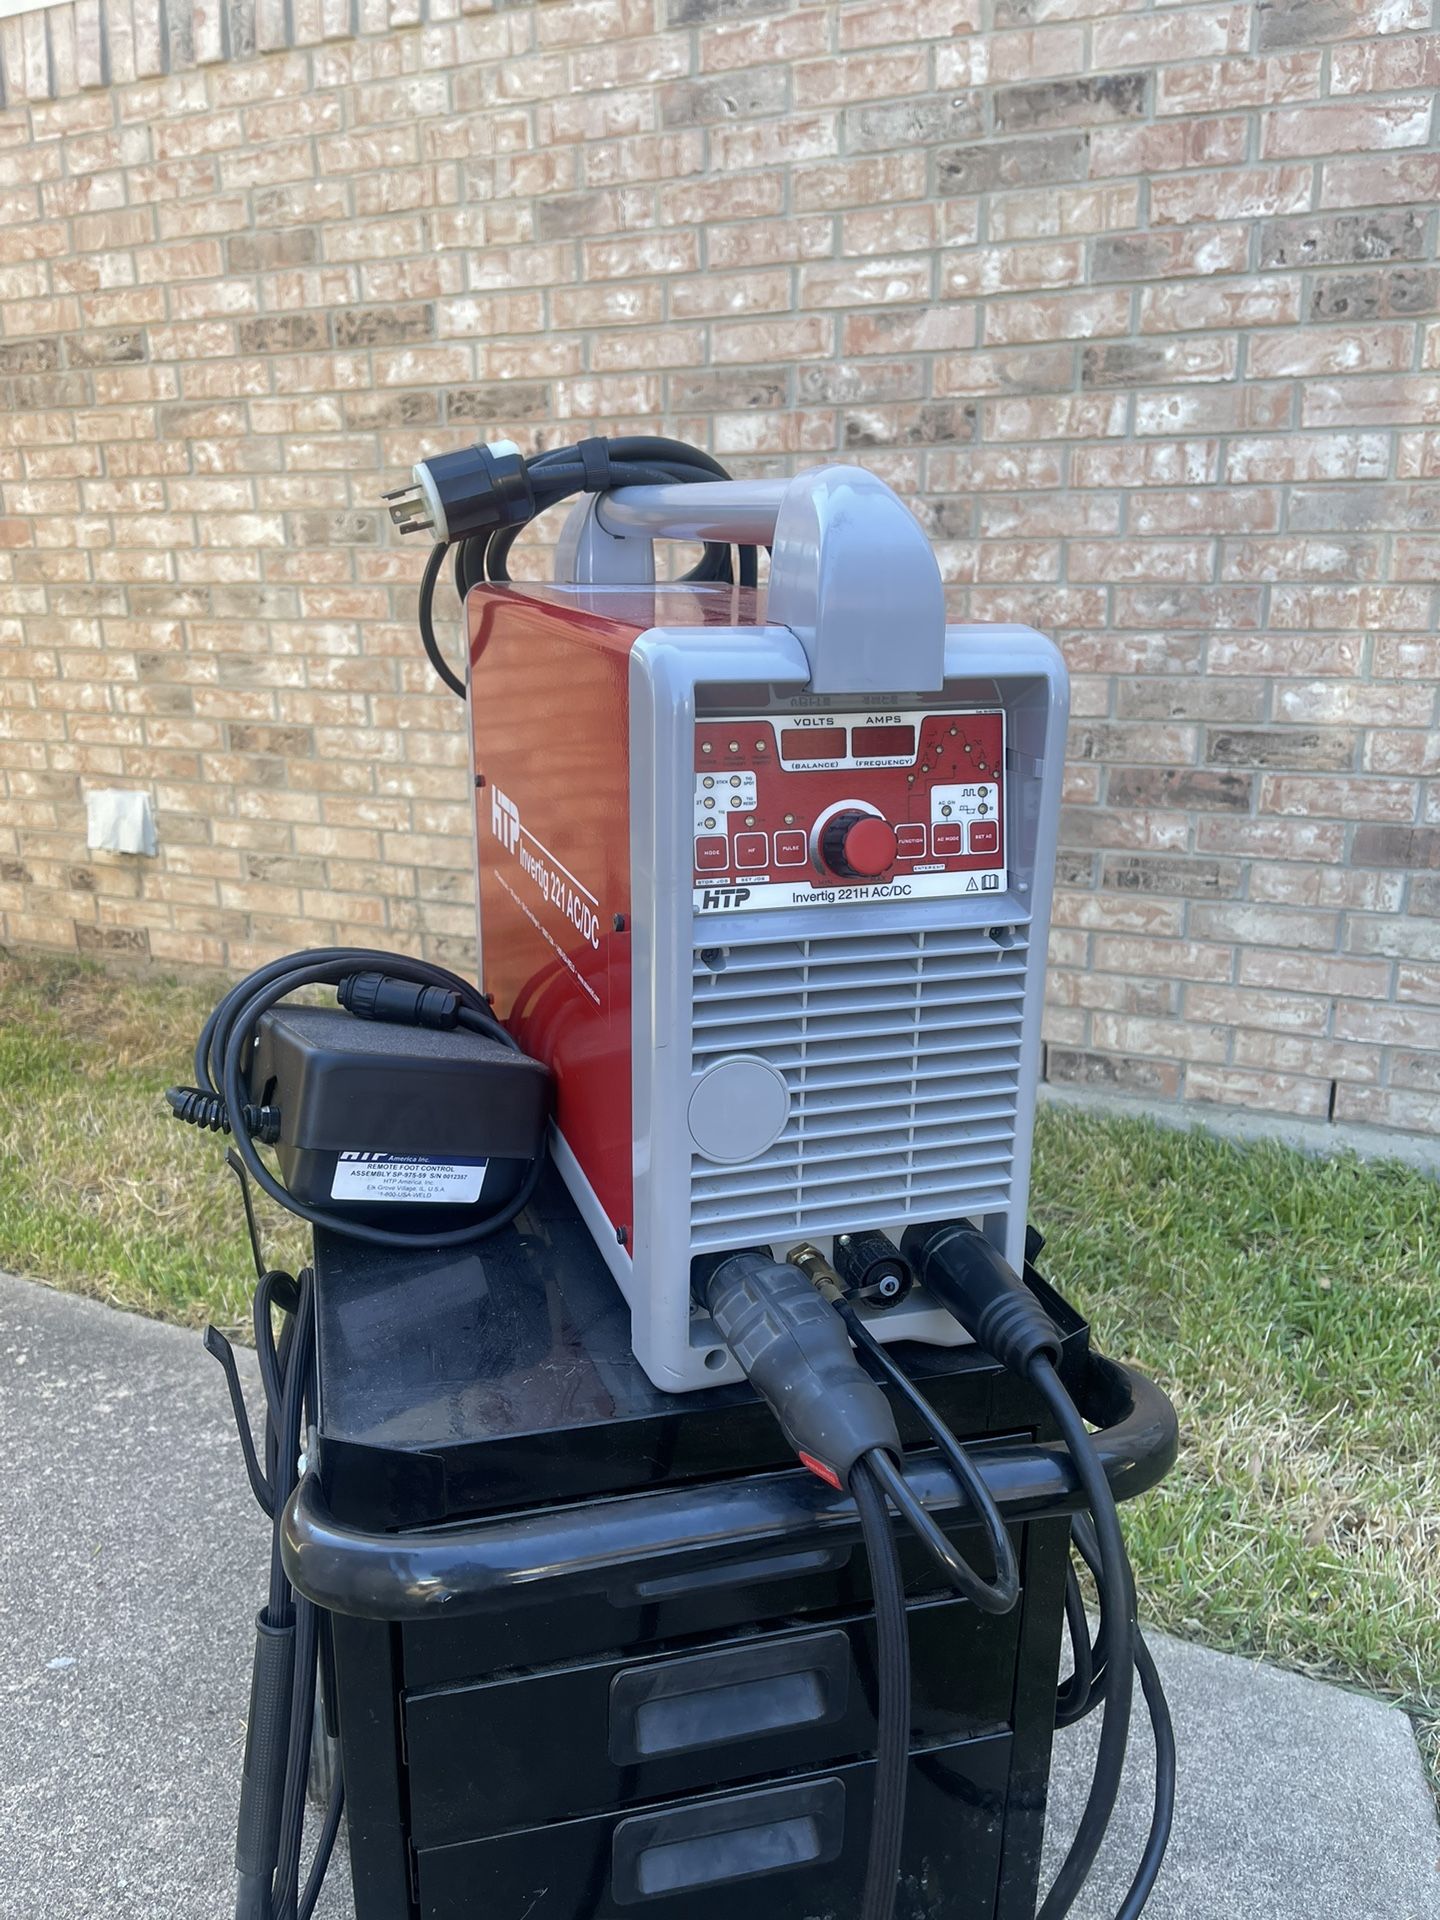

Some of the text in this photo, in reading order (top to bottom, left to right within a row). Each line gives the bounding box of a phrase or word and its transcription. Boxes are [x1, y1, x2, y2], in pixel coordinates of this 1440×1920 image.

[793, 717, 835, 726] VOLTS
[865, 715, 902, 724] AMPS
[791, 760, 839, 769] (BALANCE)
[855, 758, 913, 767] (FREQUENCY)
[491, 784, 520, 855] HTP
[519, 838, 549, 901] Invertig
[550, 871, 566, 913] 221
[566, 889, 600, 950] AC/DC
[702, 887, 750, 909] HTP
[792, 885, 912, 903] Invertig 221H AC/DC
